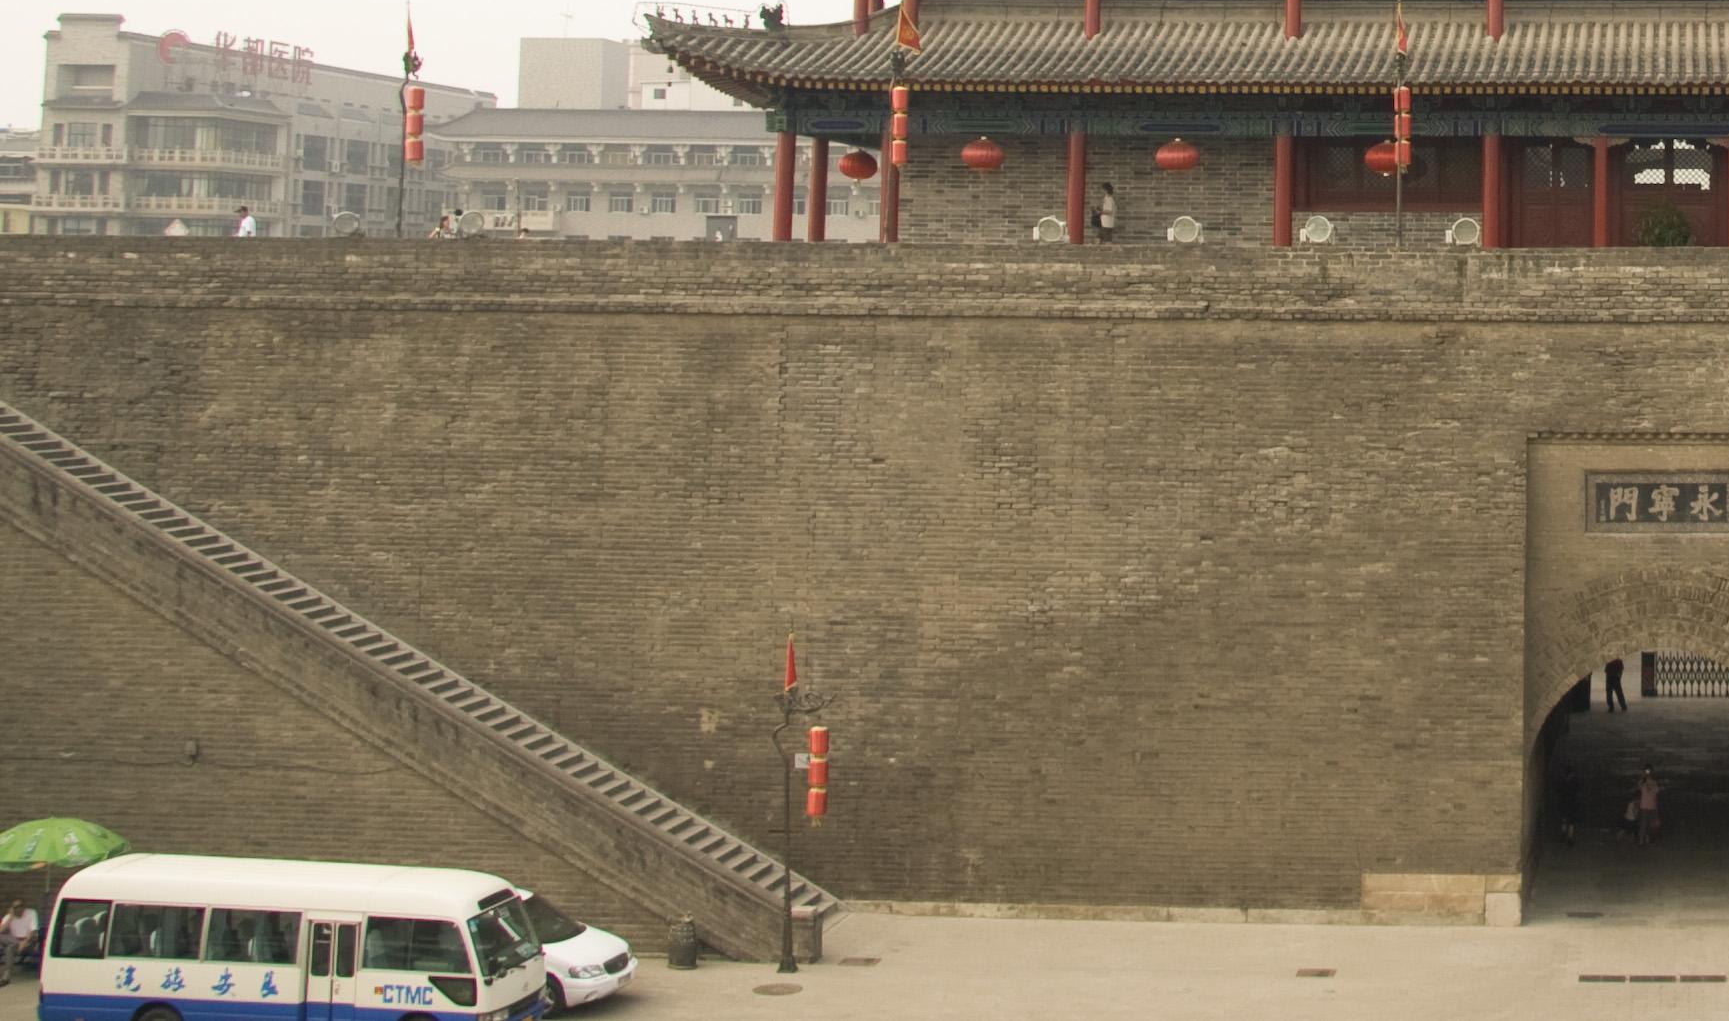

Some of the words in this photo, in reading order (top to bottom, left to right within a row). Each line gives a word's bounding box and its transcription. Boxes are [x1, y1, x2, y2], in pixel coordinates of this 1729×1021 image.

[215, 30, 314, 85] 华都医院
[383, 984, 433, 1005] CTMC
